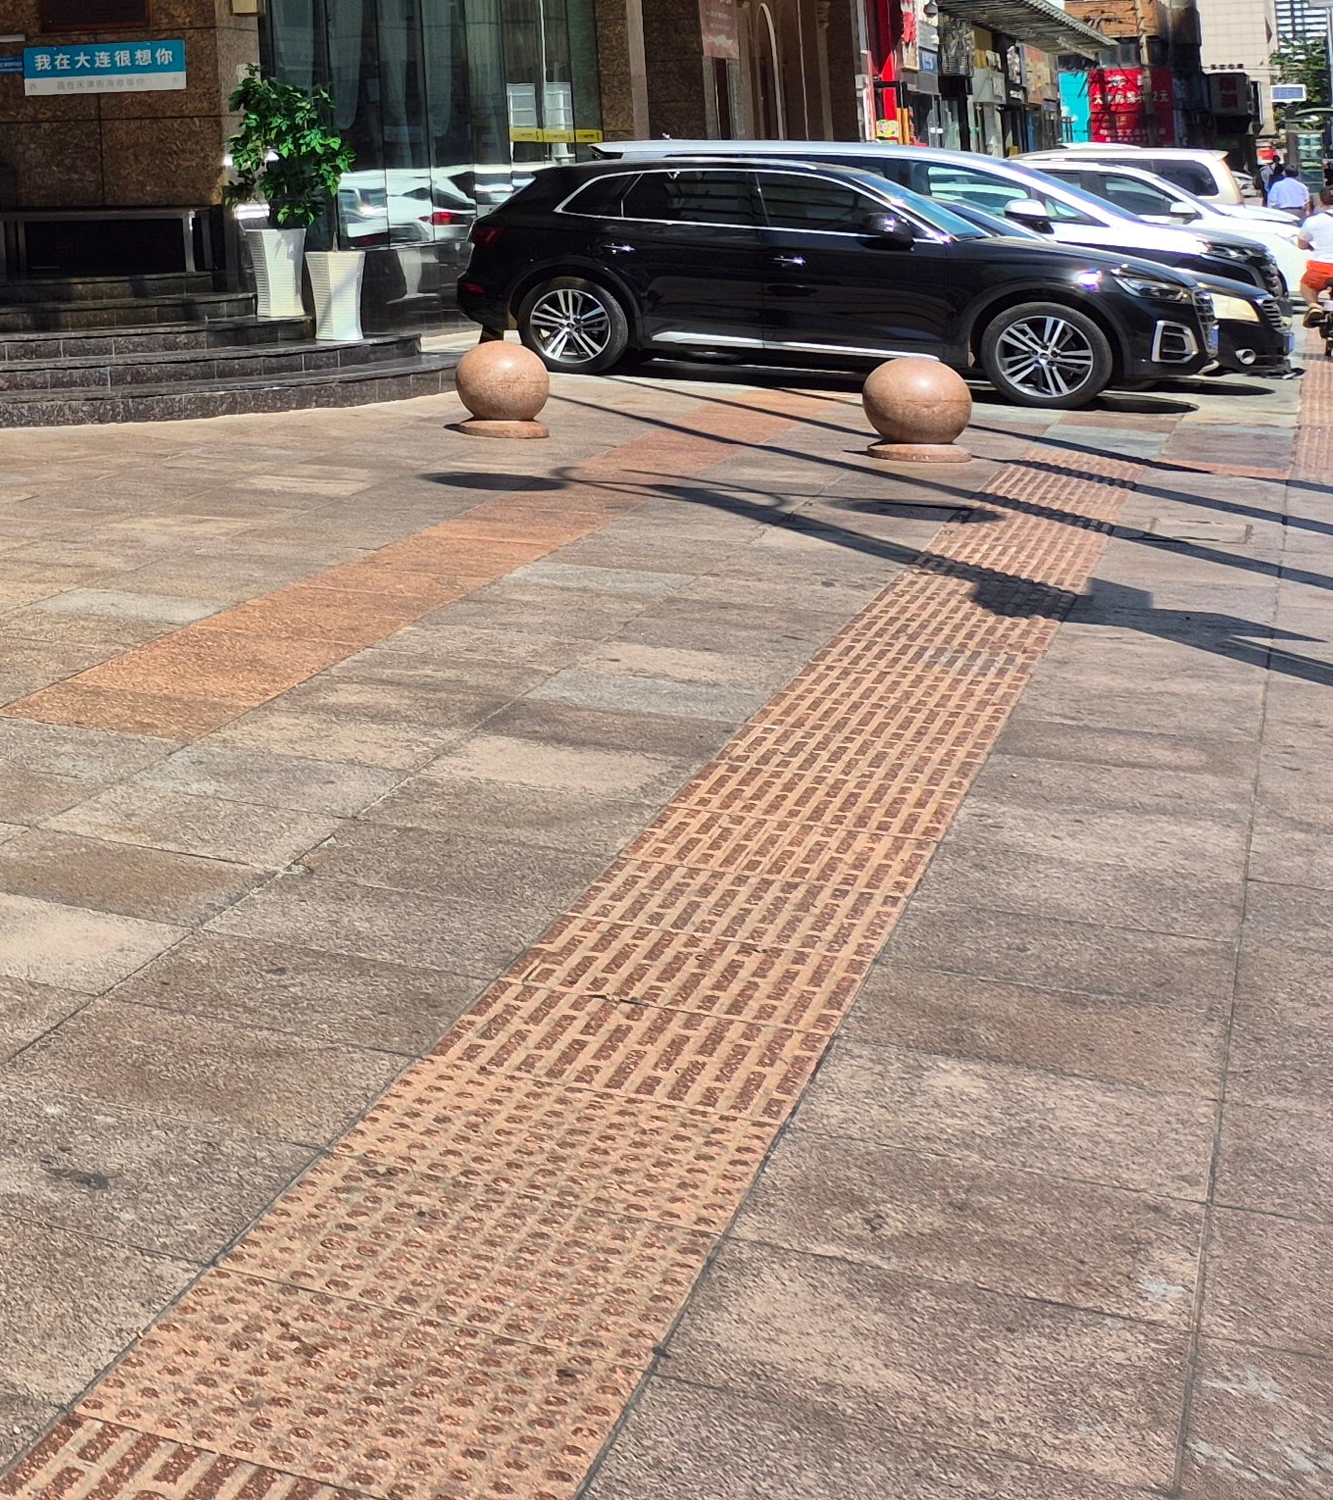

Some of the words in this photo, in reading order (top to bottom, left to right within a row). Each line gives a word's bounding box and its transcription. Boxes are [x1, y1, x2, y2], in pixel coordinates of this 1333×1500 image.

[35, 48, 173, 72] 我在大连很想你
